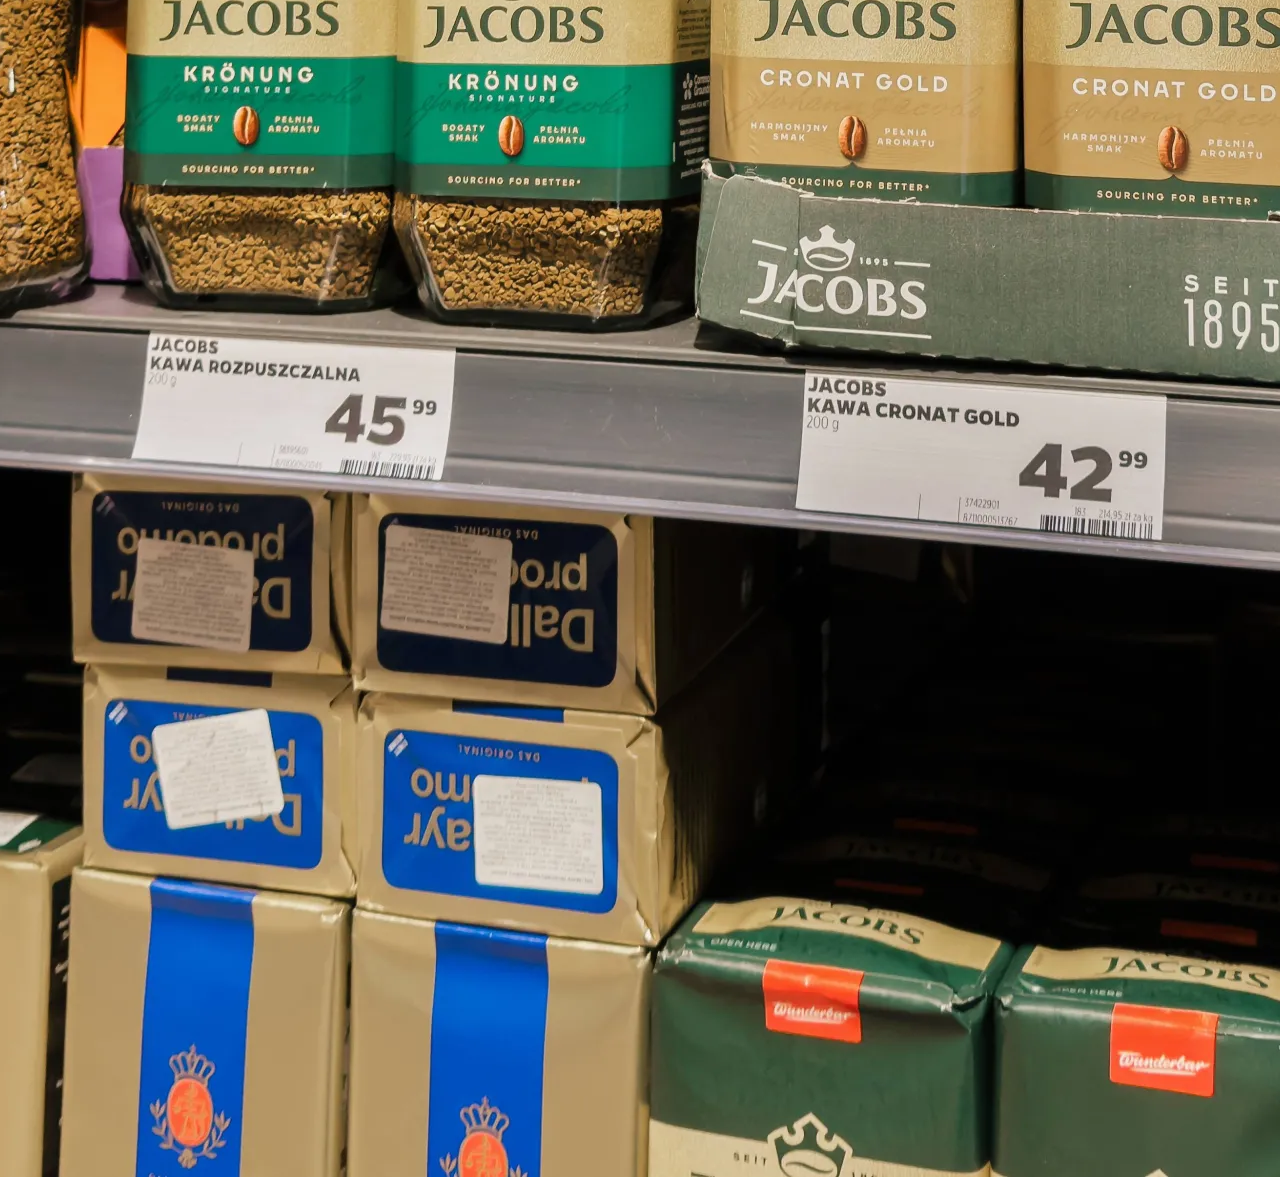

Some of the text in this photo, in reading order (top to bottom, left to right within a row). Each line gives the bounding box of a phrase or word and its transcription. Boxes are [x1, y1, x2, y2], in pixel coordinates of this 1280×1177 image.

[159, 0, 340, 42] JACOBS
[423, 6, 605, 49] JACOBS
[183, 63, 315, 84] KRÖNUNG
[448, 71, 579, 93] KRÖNUNG
[760, 69, 949, 94] CRONAT GOLD
[203, 85, 293, 95] SIGNATURE
[469, 94, 557, 104] SIGNATURE
[1072, 76, 1277, 104] CRONAT GOLD
[267, 124, 321, 134] AROMATU
[533, 134, 587, 144] AROMATU
[876, 138, 936, 149] AROMATU
[182, 164, 264, 175] SOURCING FOR
[447, 175, 530, 187] SOURCING FOR
[849, 178, 875, 190] FOR
[1096, 189, 1198, 205] SOURCING FOR
[1183, 273, 1280, 294] SEIT
[1183, 297, 1280, 353] 1895
[151, 338, 218, 354] JACOBS
[150, 357, 360, 382] KAWA ROZPUSZCZALNA
[808, 377, 887, 397] JACOBS
[325, 393, 437, 446] 45 99
[806, 415, 829, 430] 200
[808, 399, 1020, 427] KAWA CRONAT GOLD
[1019, 443, 1147, 503] 42 99
[768, 905, 925, 945] JACOBS
[1101, 955, 1271, 990] JACOBS
[772, 1000, 853, 1022] Wunderbar
[1116, 1050, 1210, 1076] Wunderbar
[733, 1151, 768, 1167] SEIT
